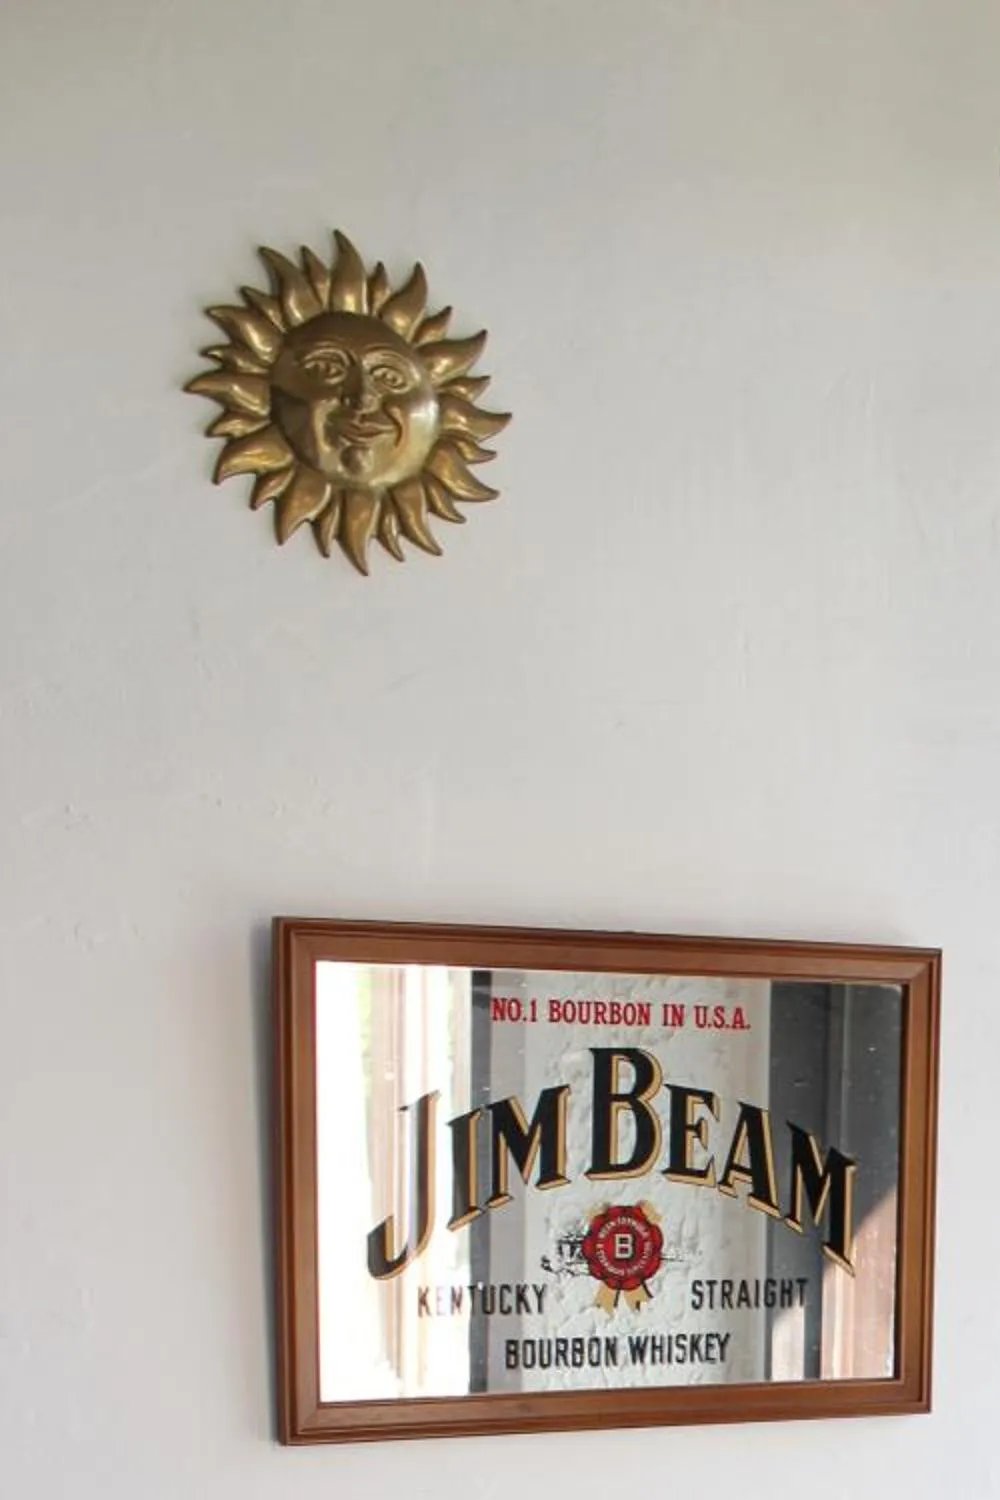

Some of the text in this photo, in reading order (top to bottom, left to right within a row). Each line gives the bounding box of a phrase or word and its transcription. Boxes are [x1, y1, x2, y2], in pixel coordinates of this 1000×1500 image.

[491, 997, 752, 1030] NO.1 BOURBON IN U.S.A.
[367, 1046, 857, 1281] JIM BEAM
[417, 1278, 809, 1318] KENTUCKY STRAIGHT
[505, 1331, 732, 1369] BOURBON WHISKEY
